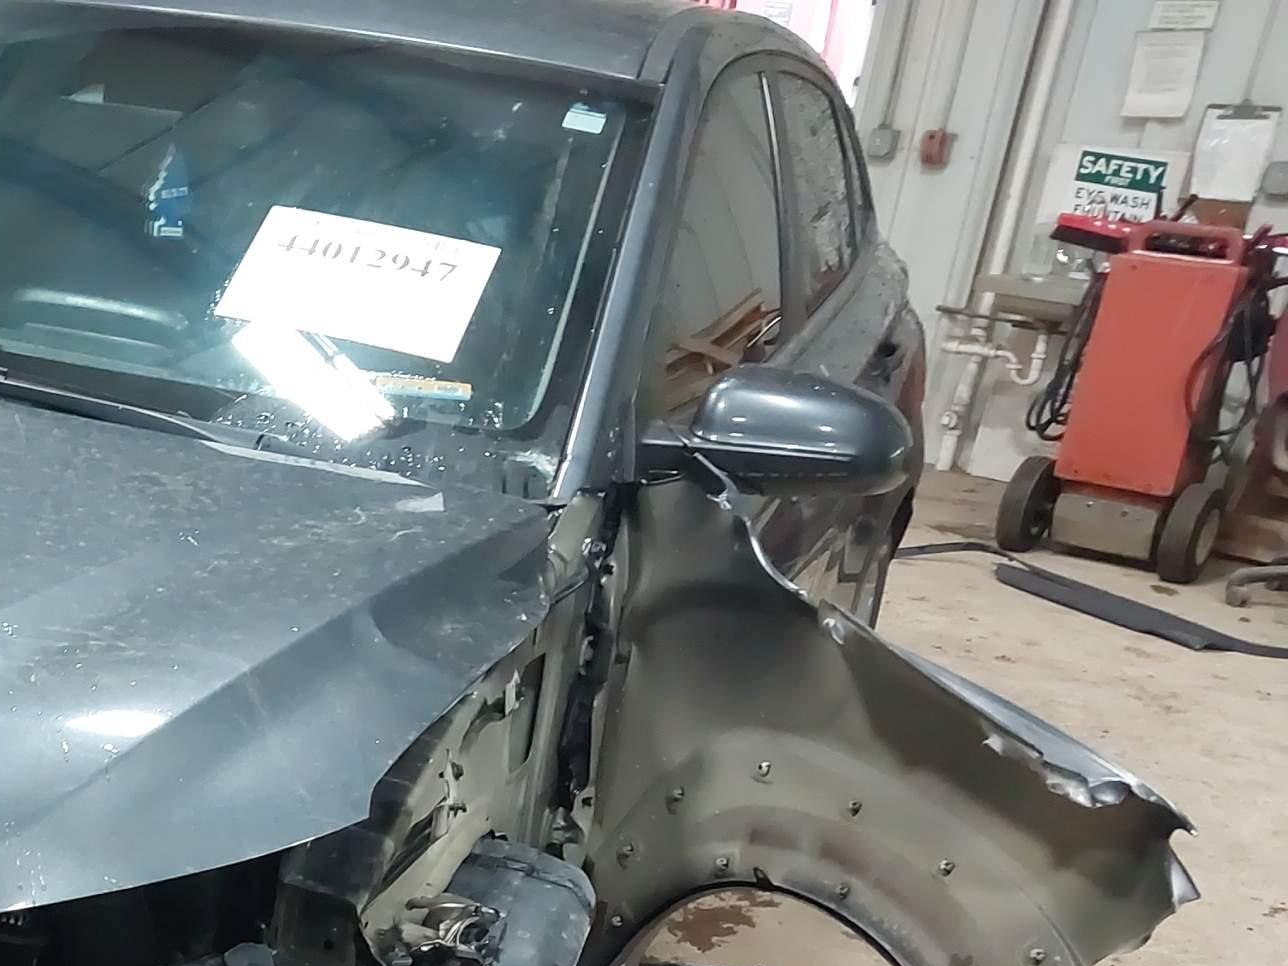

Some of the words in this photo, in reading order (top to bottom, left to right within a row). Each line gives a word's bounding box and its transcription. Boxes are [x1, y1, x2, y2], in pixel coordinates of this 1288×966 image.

[1079, 155, 1165, 184] SAFETY
[1109, 192, 1151, 210] WASH
[277, 234, 459, 281] 44012947
